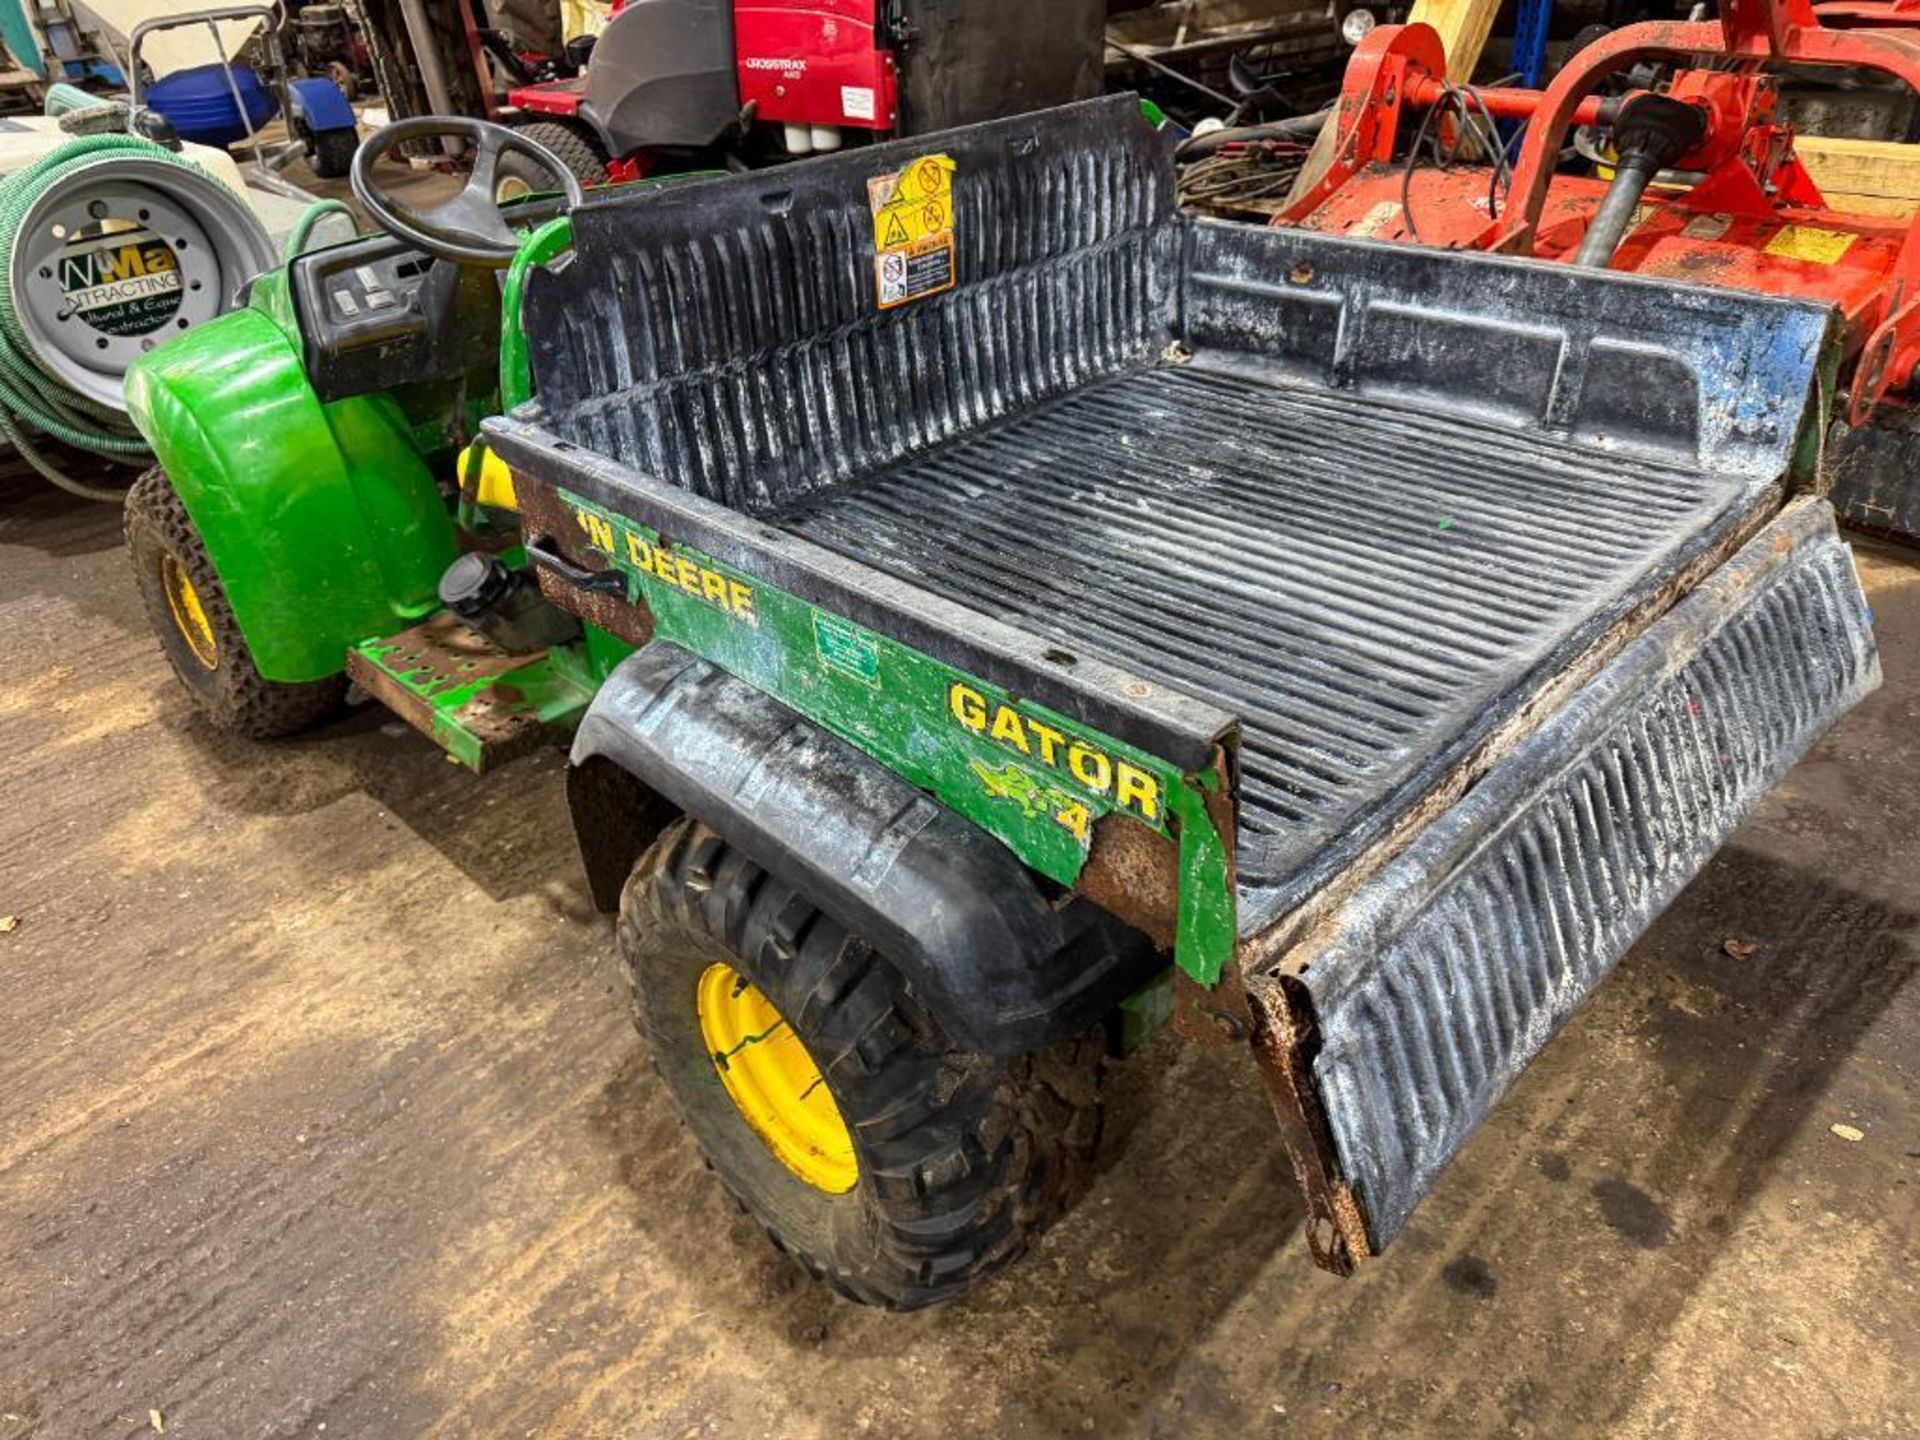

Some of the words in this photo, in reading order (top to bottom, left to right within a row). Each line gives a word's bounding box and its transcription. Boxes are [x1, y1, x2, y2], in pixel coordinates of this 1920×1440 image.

[745, 57, 807, 71] CROSSTRAX
[625, 529, 759, 629] DEERE
[949, 682, 1159, 821] GATOR
